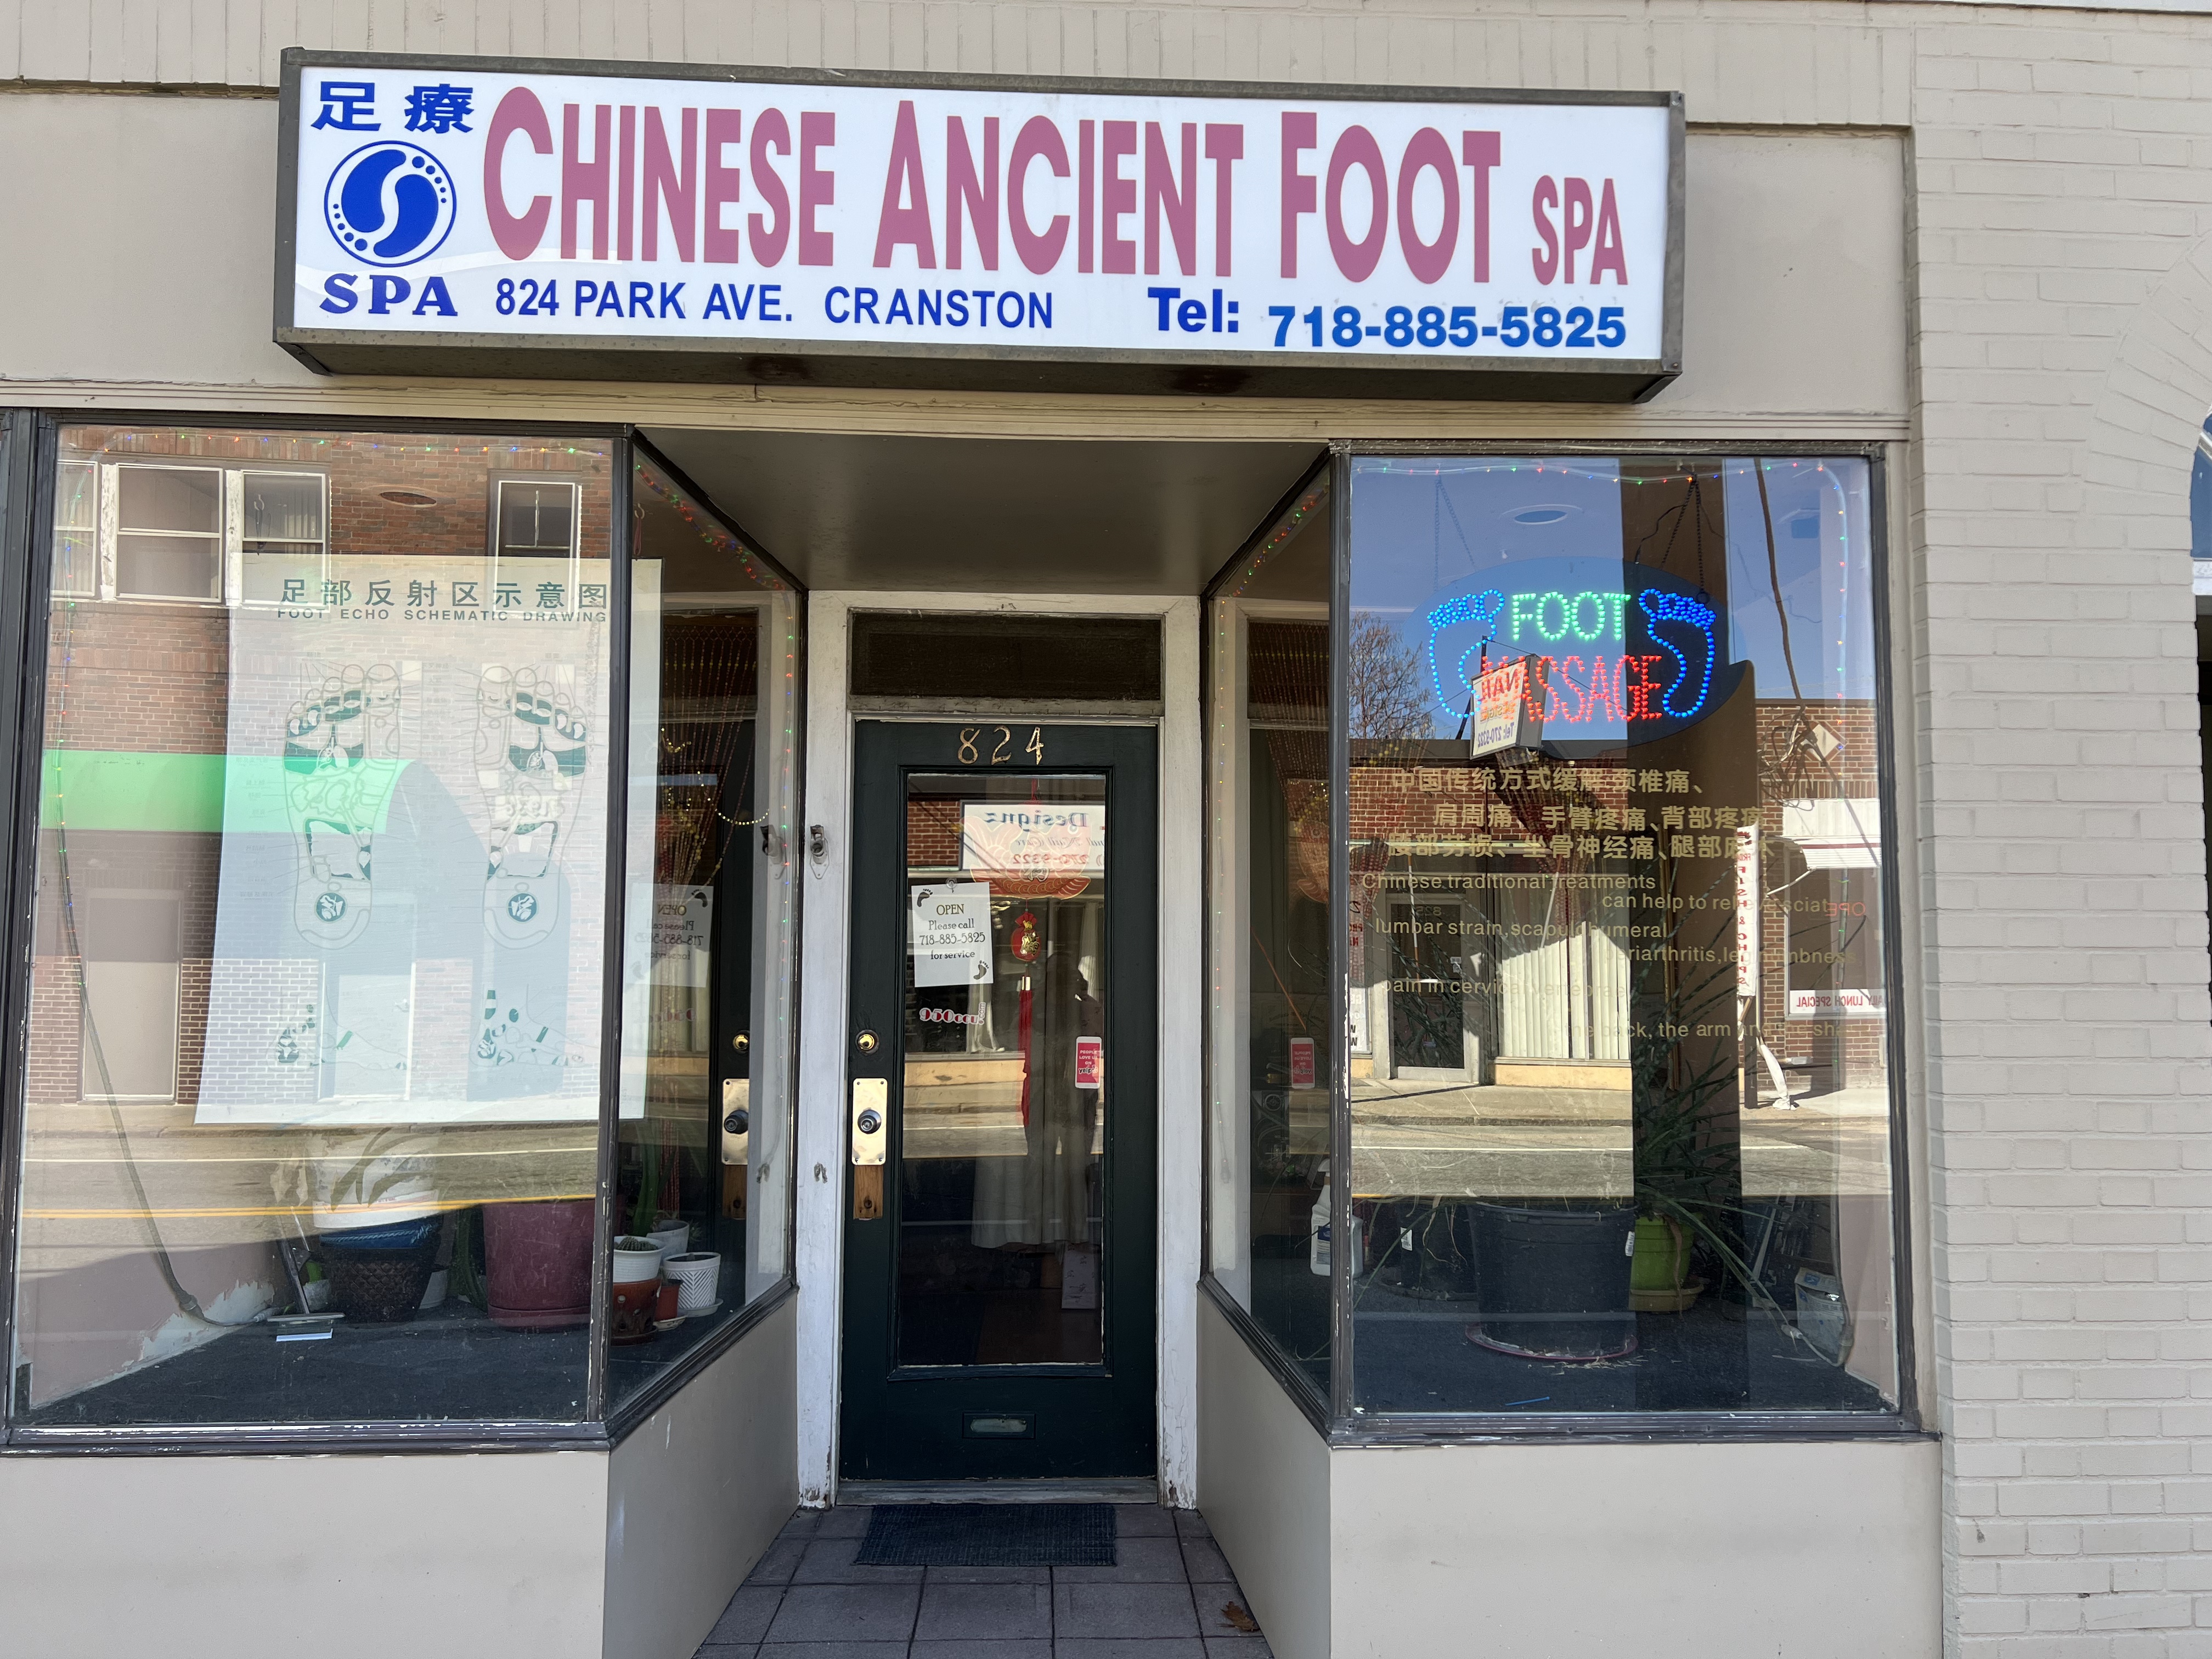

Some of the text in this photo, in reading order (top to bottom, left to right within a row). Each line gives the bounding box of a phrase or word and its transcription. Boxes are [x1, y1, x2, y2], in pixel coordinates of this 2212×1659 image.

[311, 81, 473, 133] 足療
[483, 86, 1628, 285] CHINESE ANCIENT FOOT SPA
[319, 273, 458, 317] SPA
[495, 278, 1626, 347] 824 PARK AVE. CRANSTON Tel: 718-885-5825
[280, 579, 608, 610] 足部反射区示意图
[278, 608, 606, 622] FOOT ECHO SCHEMATIC DRAWING
[1511, 591, 1631, 641] FOOT
[957, 725, 1044, 765] 824
[1362, 874, 1656, 889] Chinese traditional treatments
[936, 904, 964, 916] OPEN
[1602, 898, 1637, 908] can
[1643, 895, 1684, 912] help
[1689, 897, 1706, 909] to
[1712, 897, 1782, 911] releve
[928, 918, 975, 930] Please call
[1376, 920, 1442, 934] lumbar
[919, 932, 985, 946] 718-885-5825
[930, 950, 975, 960] for service
[1385, 978, 1423, 996] pain
[1427, 979, 1444, 992] in
[1601, 1022, 1653, 1039] back,
[1659, 1022, 1689, 1037] the
[1696, 1025, 1731, 1037] arm
